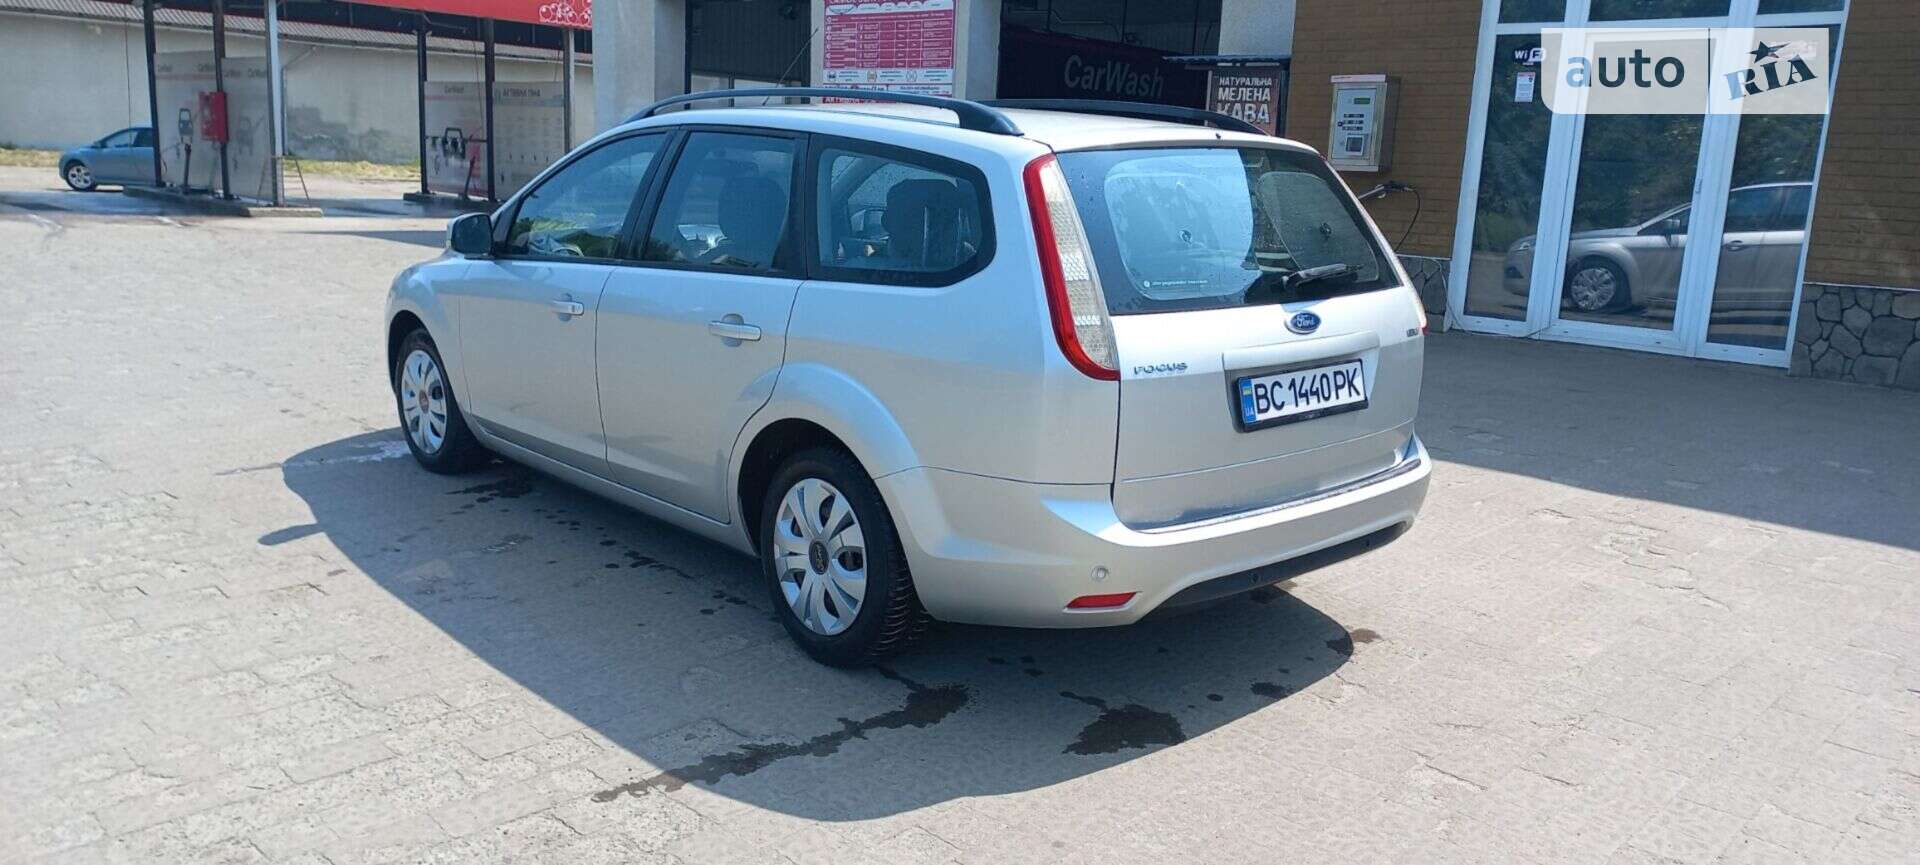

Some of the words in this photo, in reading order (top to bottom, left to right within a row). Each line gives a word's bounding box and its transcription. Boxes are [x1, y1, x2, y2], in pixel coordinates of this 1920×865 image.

[1064, 54, 1164, 97] CarWash
[1219, 76, 1273, 86] НАТУРАЛЬНА
[1218, 87, 1271, 102] МЕЛЕНА
[1216, 103, 1270, 123] КАВА
[1133, 362, 1188, 376] FOCUS
[1288, 374, 1331, 408] 1440
[1245, 407, 1255, 417] UA
